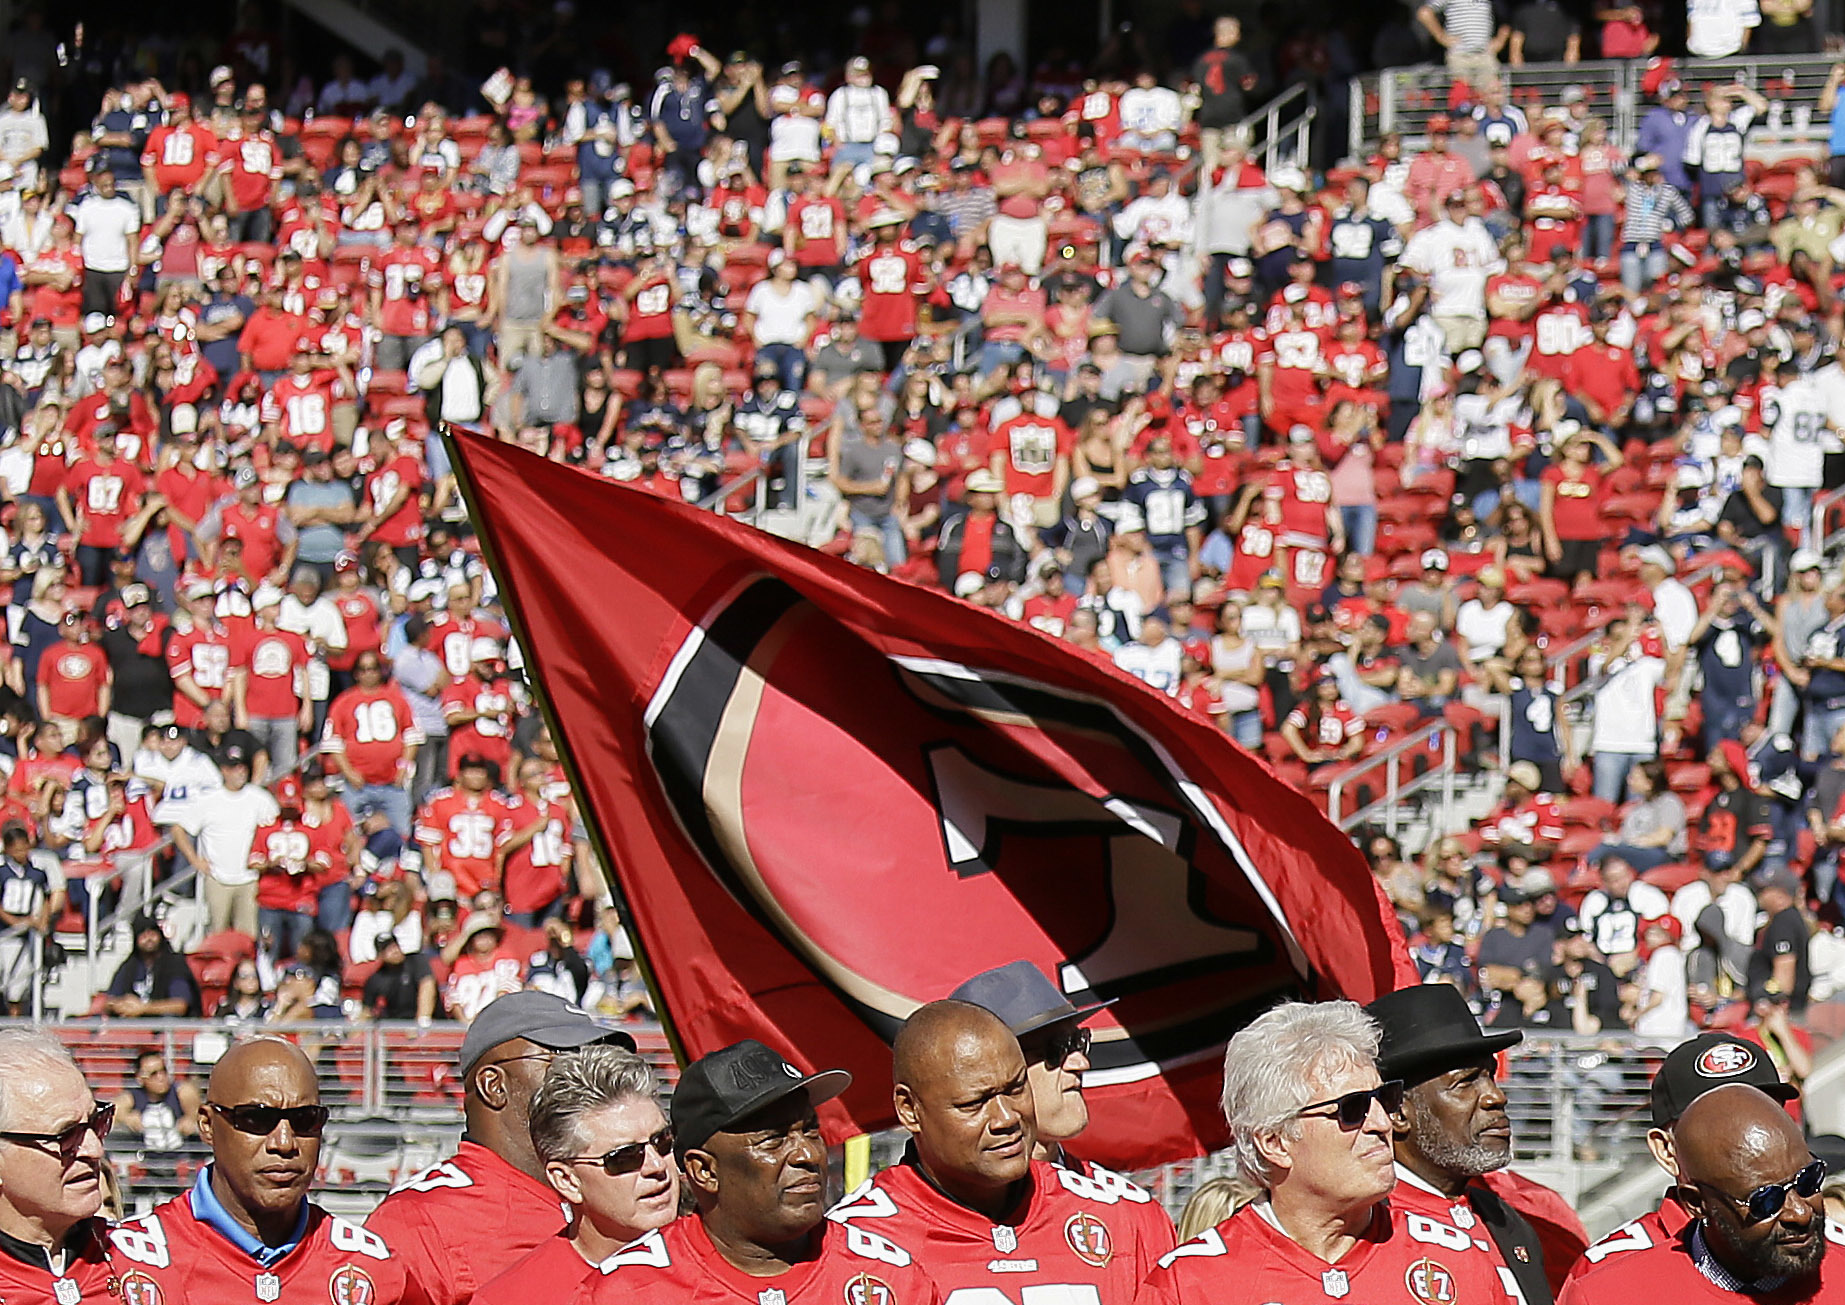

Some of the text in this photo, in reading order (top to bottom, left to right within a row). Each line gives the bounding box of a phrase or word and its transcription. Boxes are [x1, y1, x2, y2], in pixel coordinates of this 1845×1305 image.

[355, 701, 396, 742] 16
[450, 815, 494, 858] 35
[1711, 1047, 1750, 1072] SF
